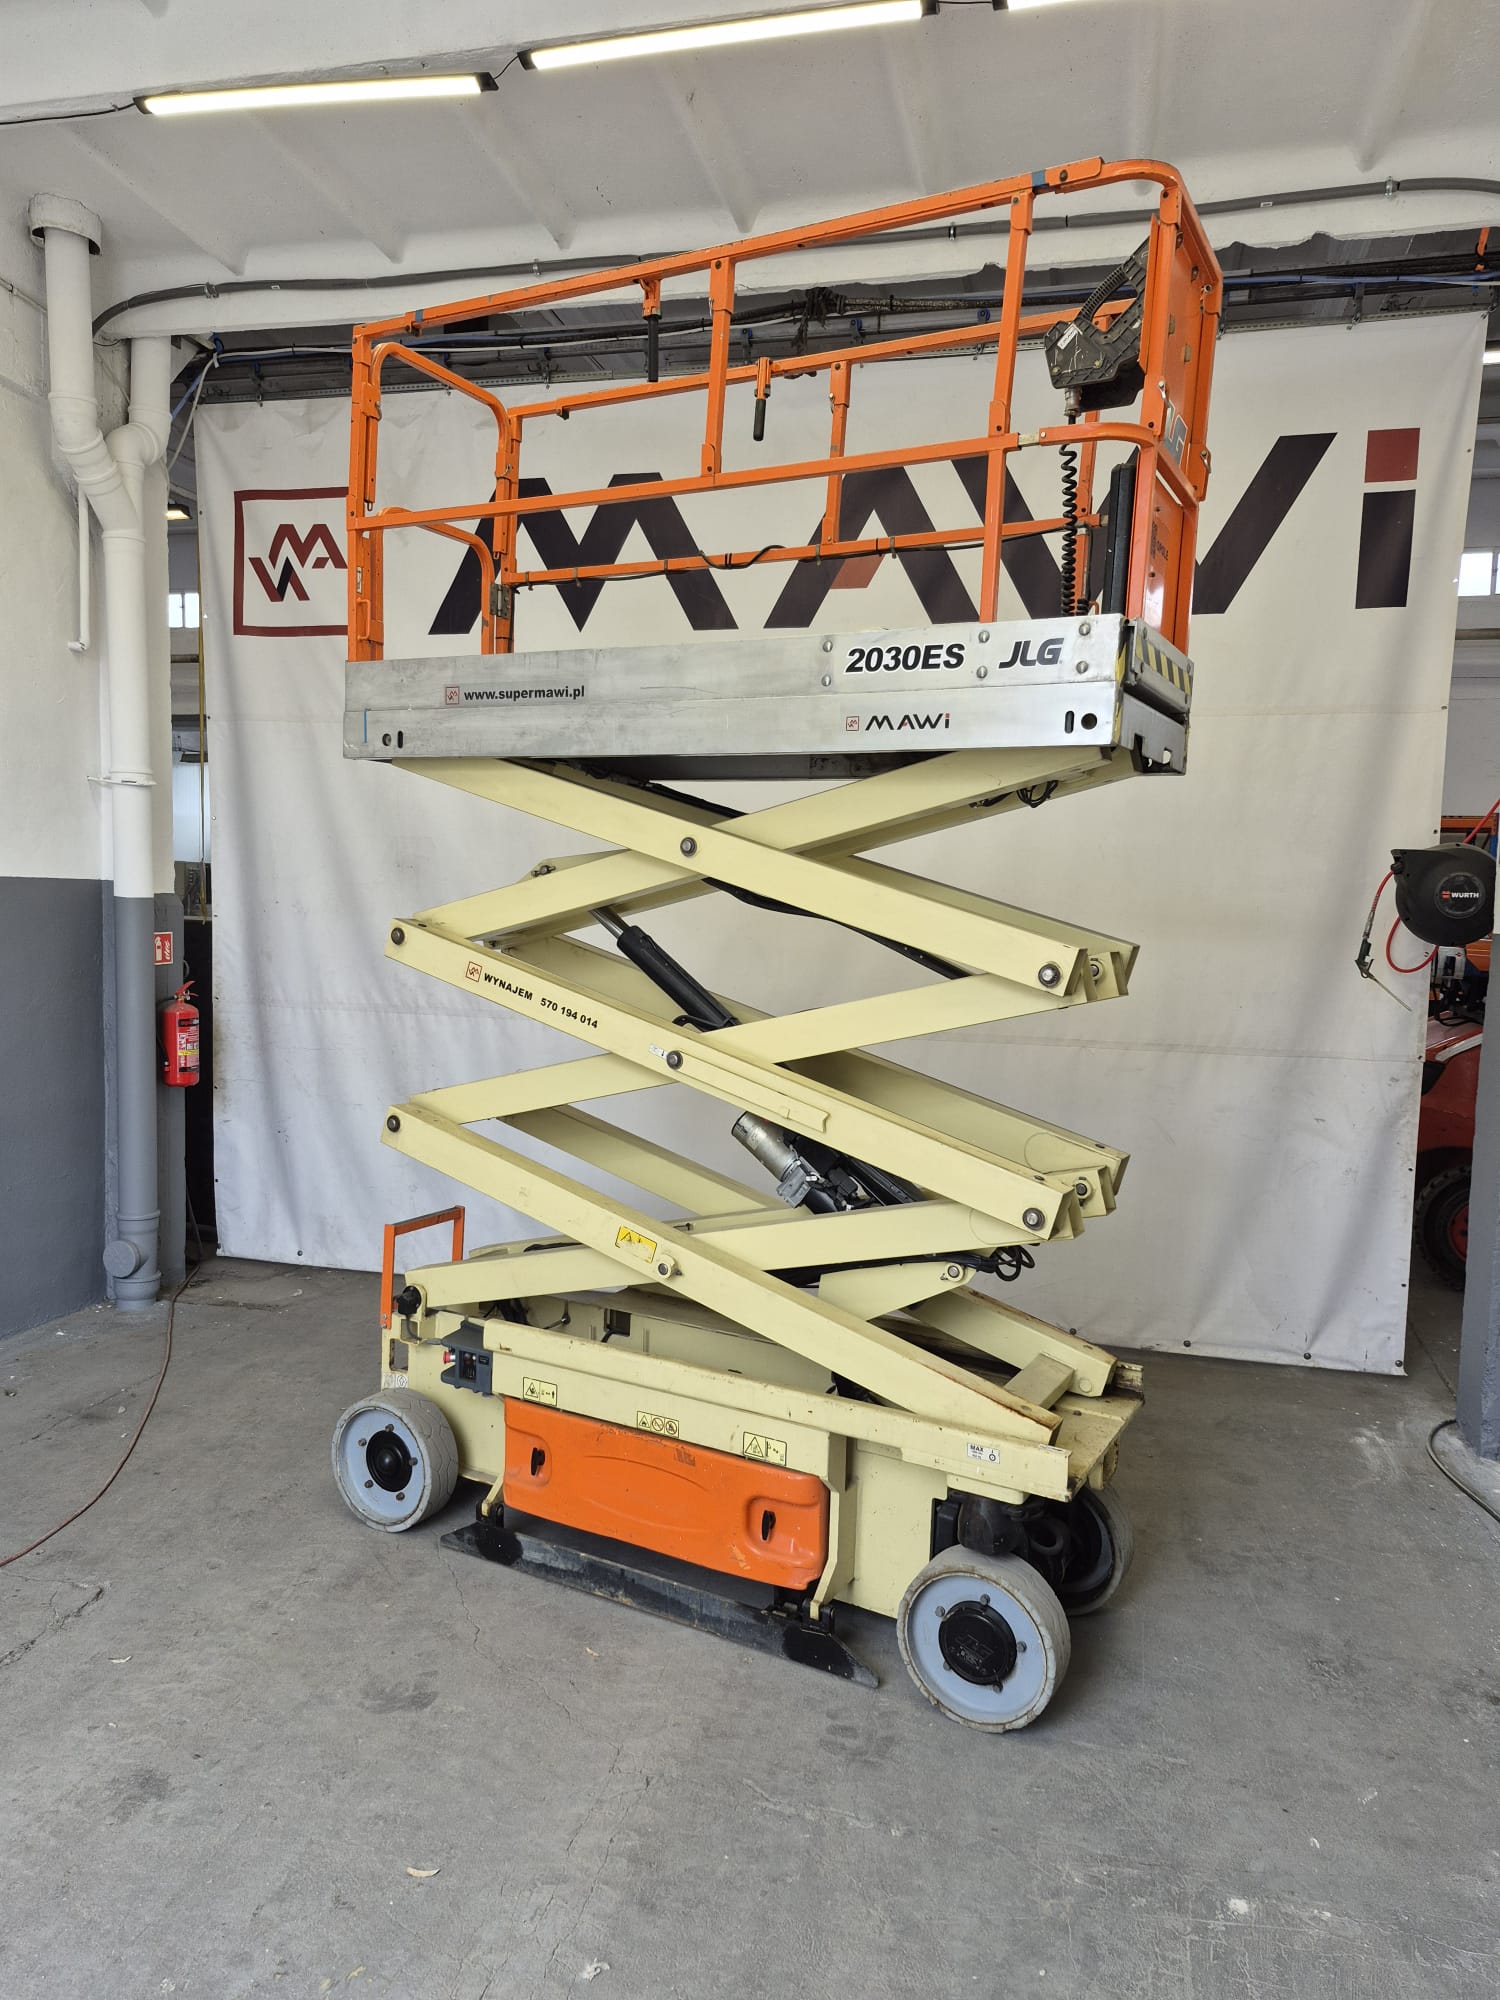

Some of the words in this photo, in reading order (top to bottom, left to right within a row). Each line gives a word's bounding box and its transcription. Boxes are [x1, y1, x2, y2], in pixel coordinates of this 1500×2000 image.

[845, 643, 966, 673] 2030ES
[999, 637, 1065, 670] JLG
[464, 685, 585, 702] www.supermawi.pl
[484, 972, 533, 1001] WYNAJEM
[540, 997, 558, 1012] 570
[560, 1006, 578, 1021] 194
[579, 1014, 599, 1029] 014
